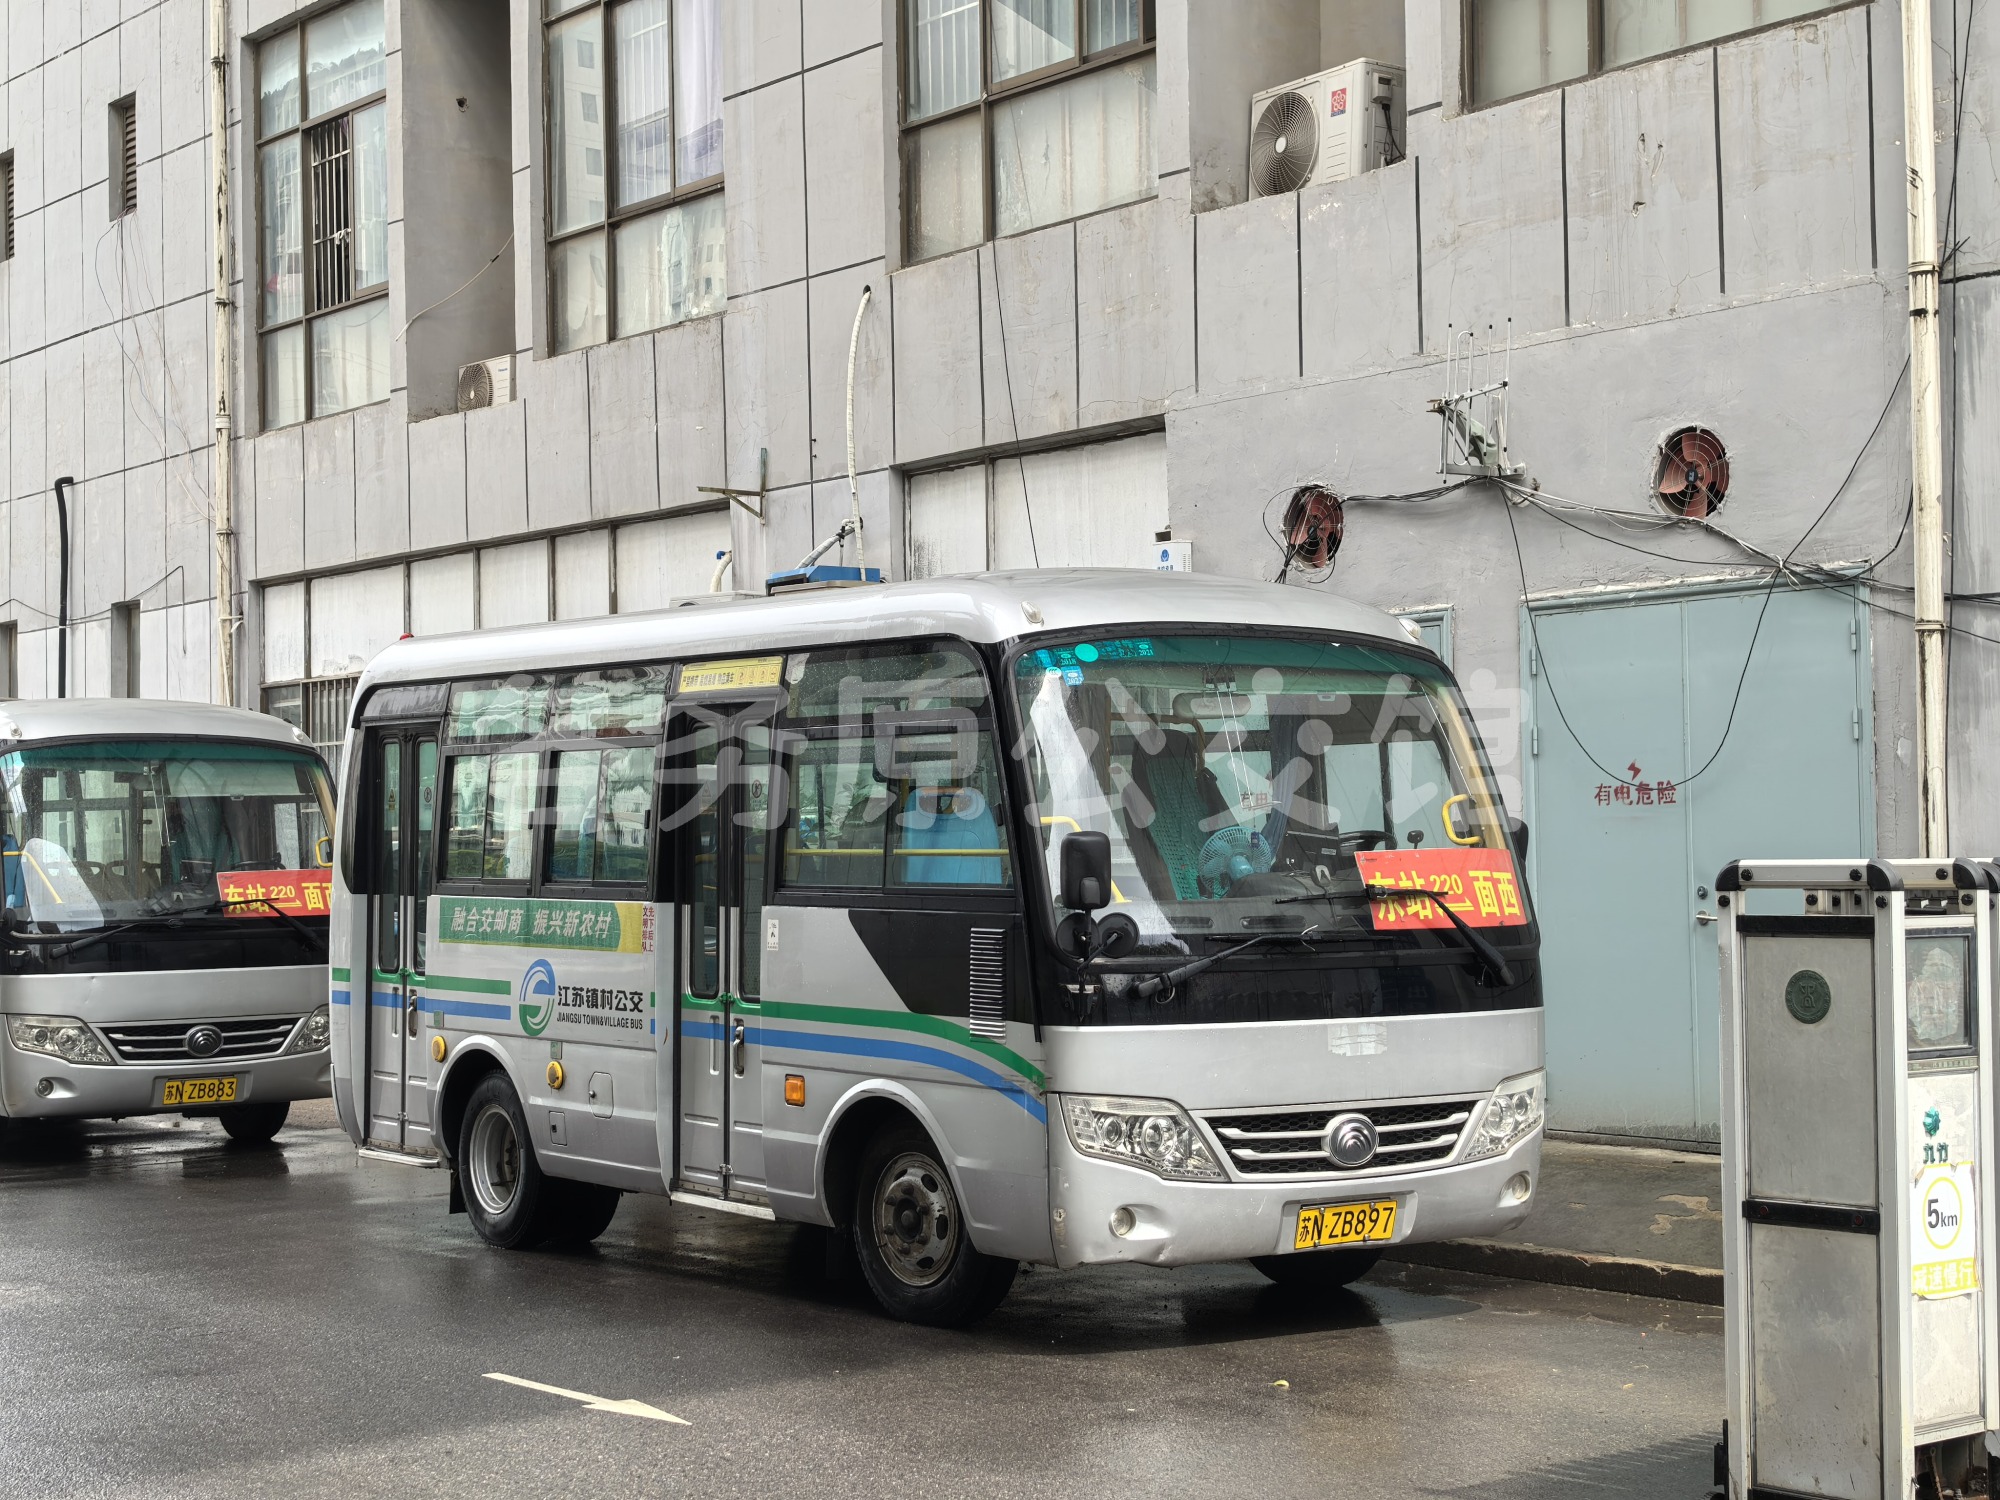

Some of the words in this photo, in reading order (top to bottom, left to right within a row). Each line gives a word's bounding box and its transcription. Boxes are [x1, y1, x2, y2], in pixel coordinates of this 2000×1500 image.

[1594, 780, 1677, 806] 有电危险
[224, 883, 270, 914] 东站
[269, 885, 296, 898] 220
[1368, 870, 1433, 922] 东站
[1429, 874, 1464, 895] 220
[1468, 870, 1521, 917] 面西
[451, 906, 524, 935] 融合交邮商
[532, 908, 612, 939] 振兴新农村
[557, 985, 644, 1013] 江苏镇村公交
[556, 1013, 582, 1024] JIANGSU
[582, 1014, 629, 1028] TOWN&VILLAGE
[630, 1018, 643, 1030] BUS
[1912, 1260, 1974, 1292] 减速慢行
